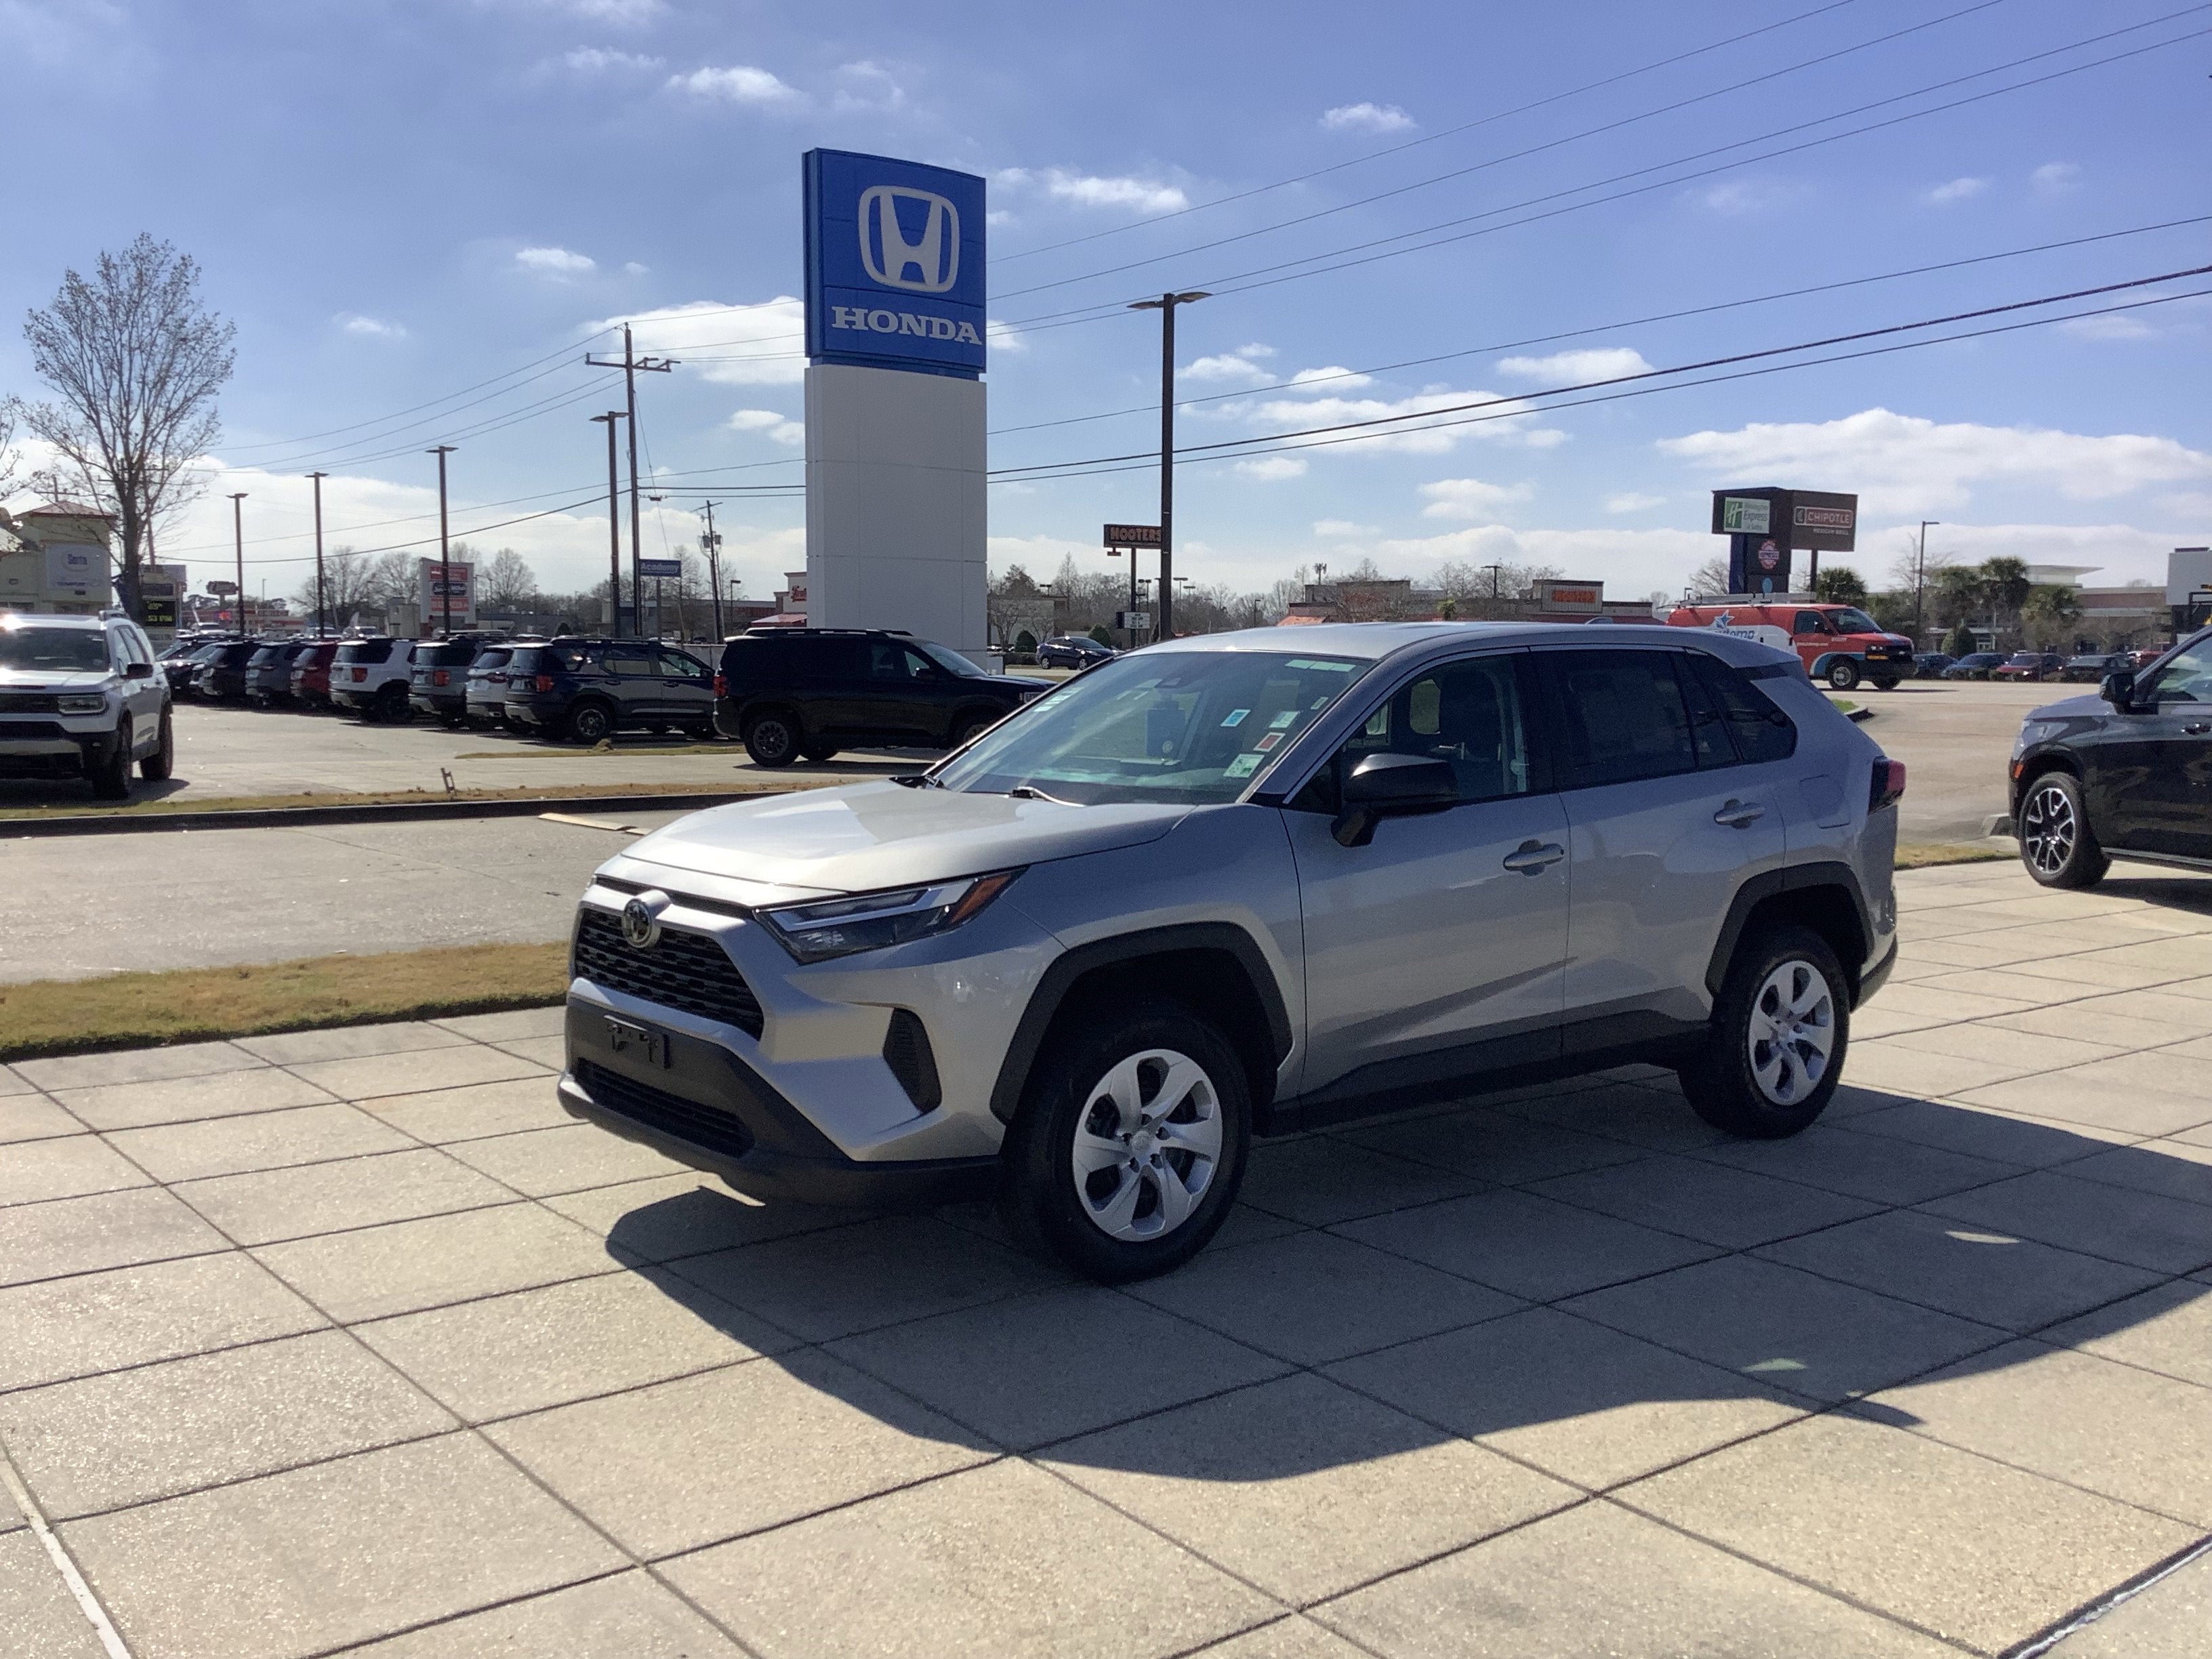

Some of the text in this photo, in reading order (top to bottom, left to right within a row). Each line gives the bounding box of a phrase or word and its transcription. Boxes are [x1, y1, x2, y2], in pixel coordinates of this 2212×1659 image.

[832, 306, 982, 345] HONDA
[1743, 510, 1768, 522] Express
[1807, 512, 1849, 524] CHIPOTLE
[640, 562, 678, 574] Academy
